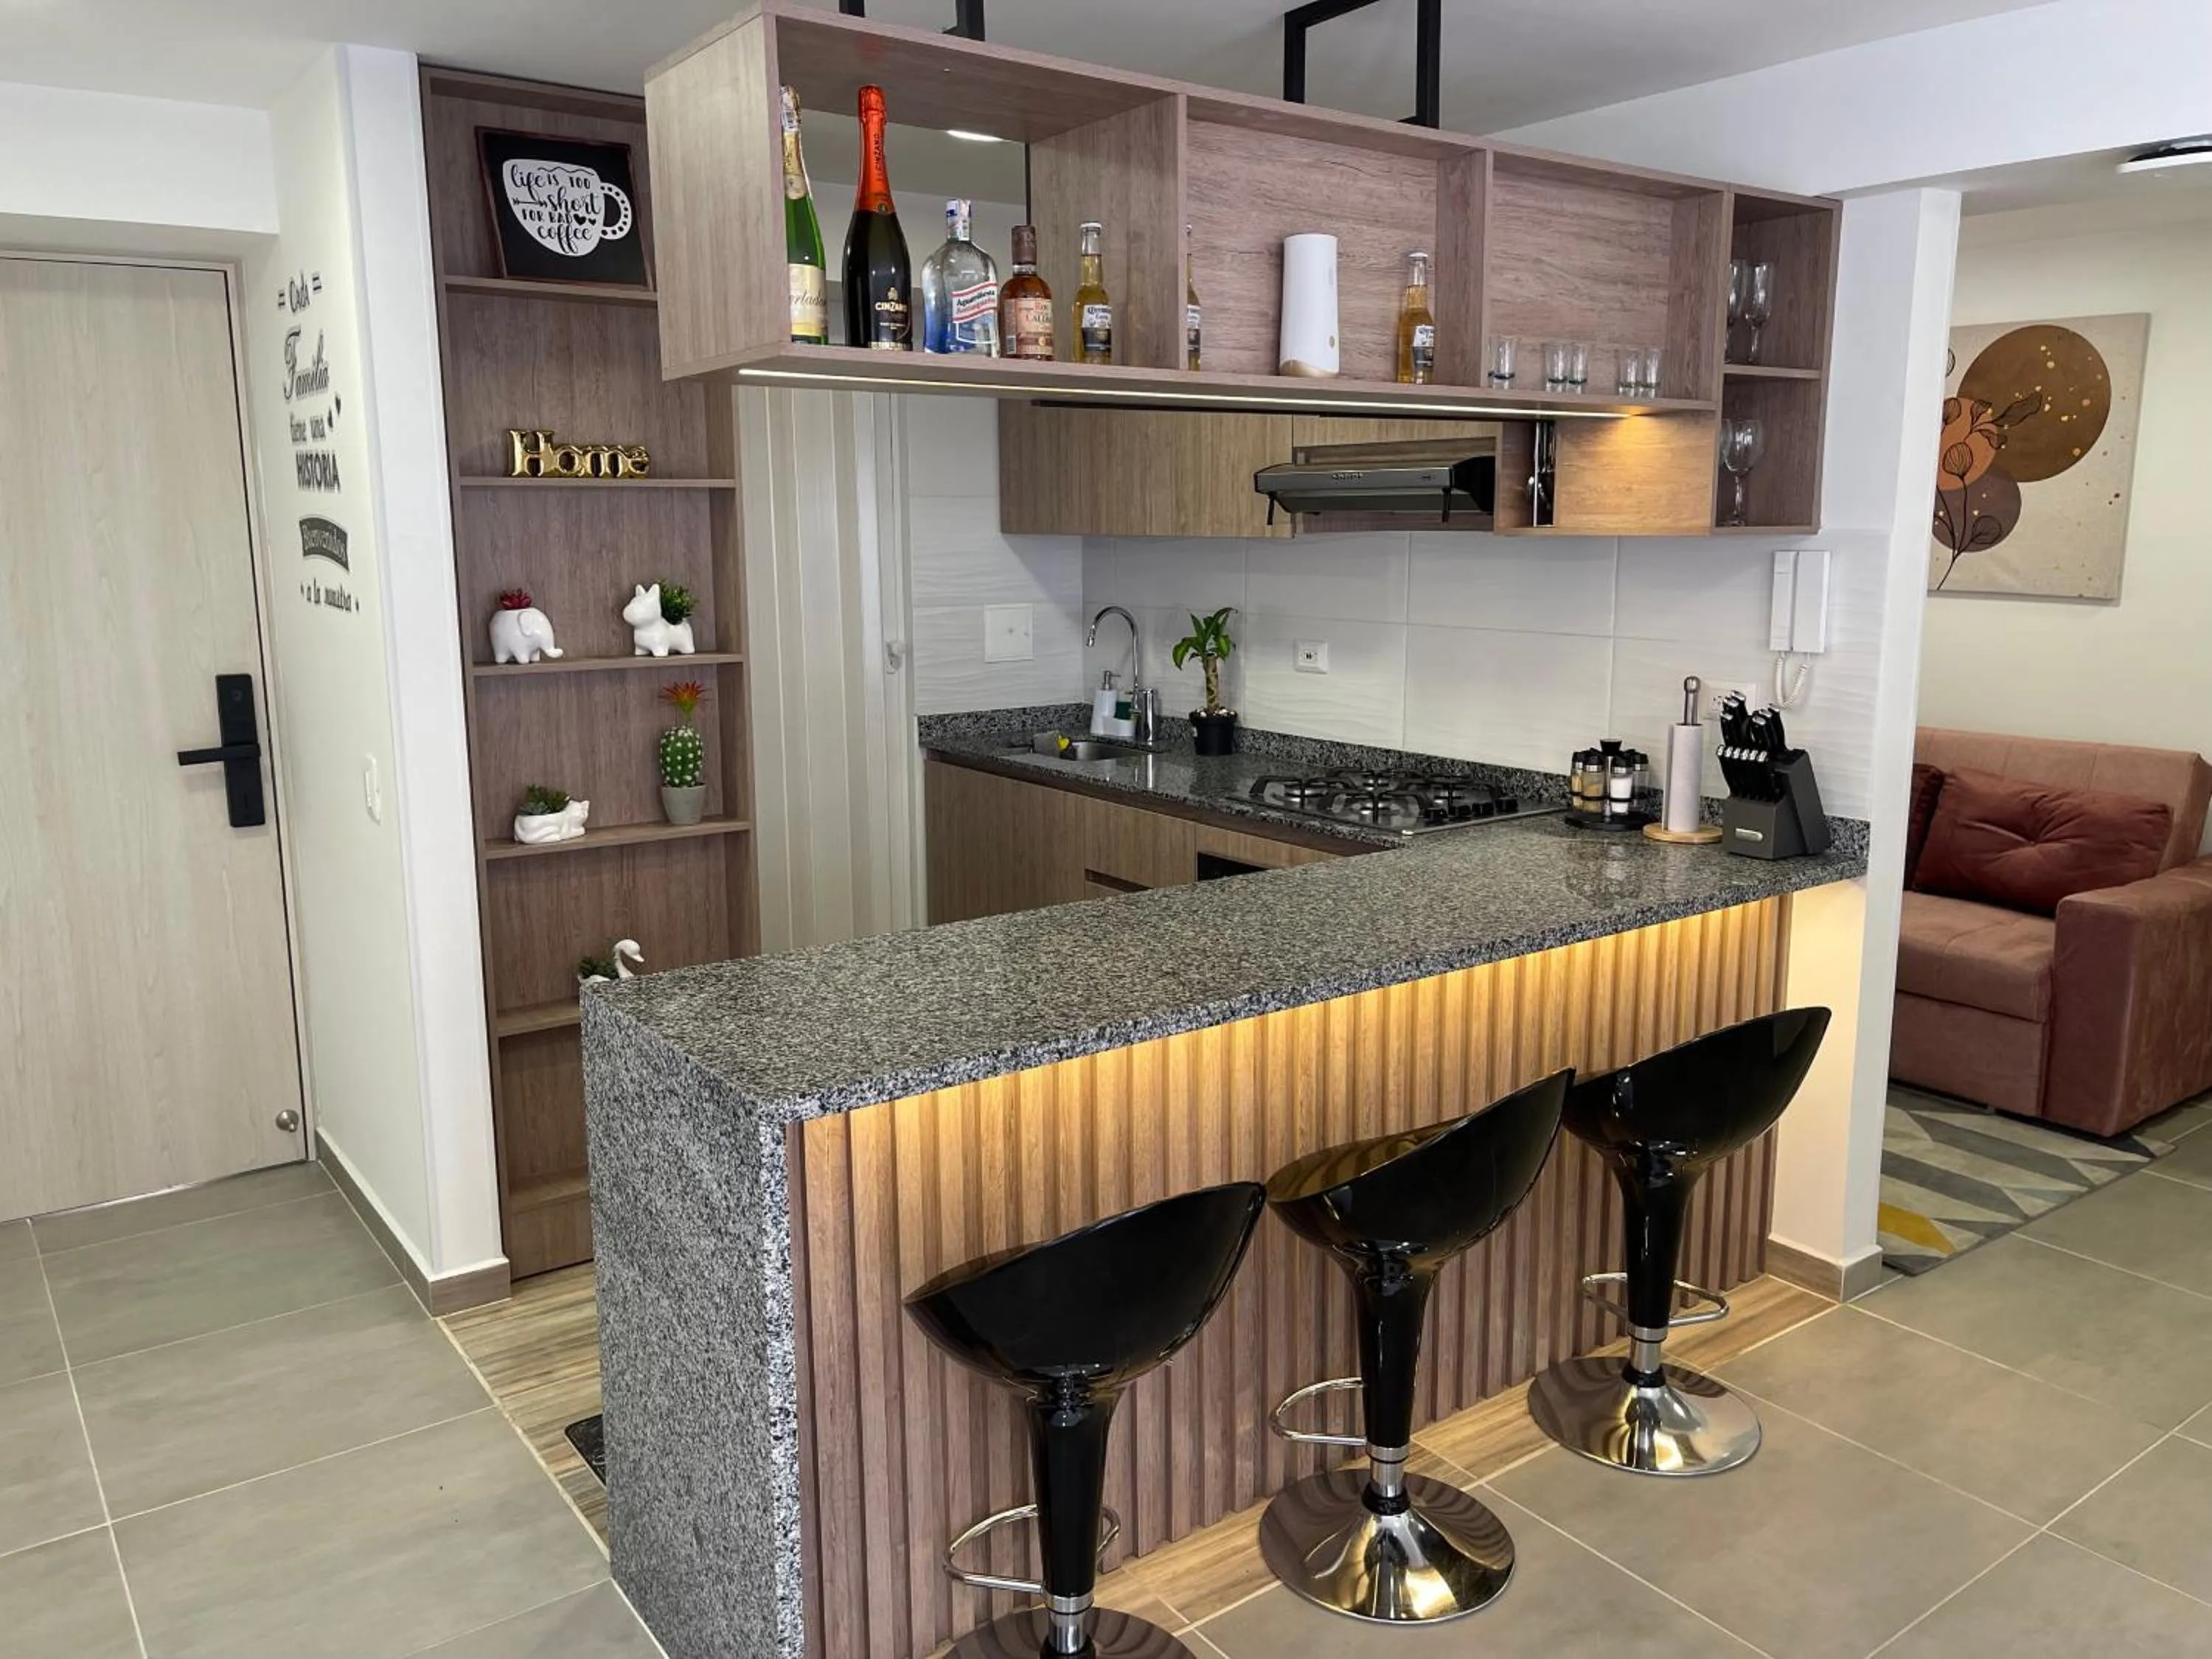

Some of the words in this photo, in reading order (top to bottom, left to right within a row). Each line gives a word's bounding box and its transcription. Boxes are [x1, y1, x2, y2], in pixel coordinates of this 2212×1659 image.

[510, 164, 545, 202] life
[547, 186, 602, 215] short
[538, 223, 591, 254] coffee
[283, 328, 330, 400] Familia
[296, 451, 341, 492] HISTORIA
[507, 429, 649, 478] Home
[306, 585, 312, 603] a
[313, 578, 321, 605] la
